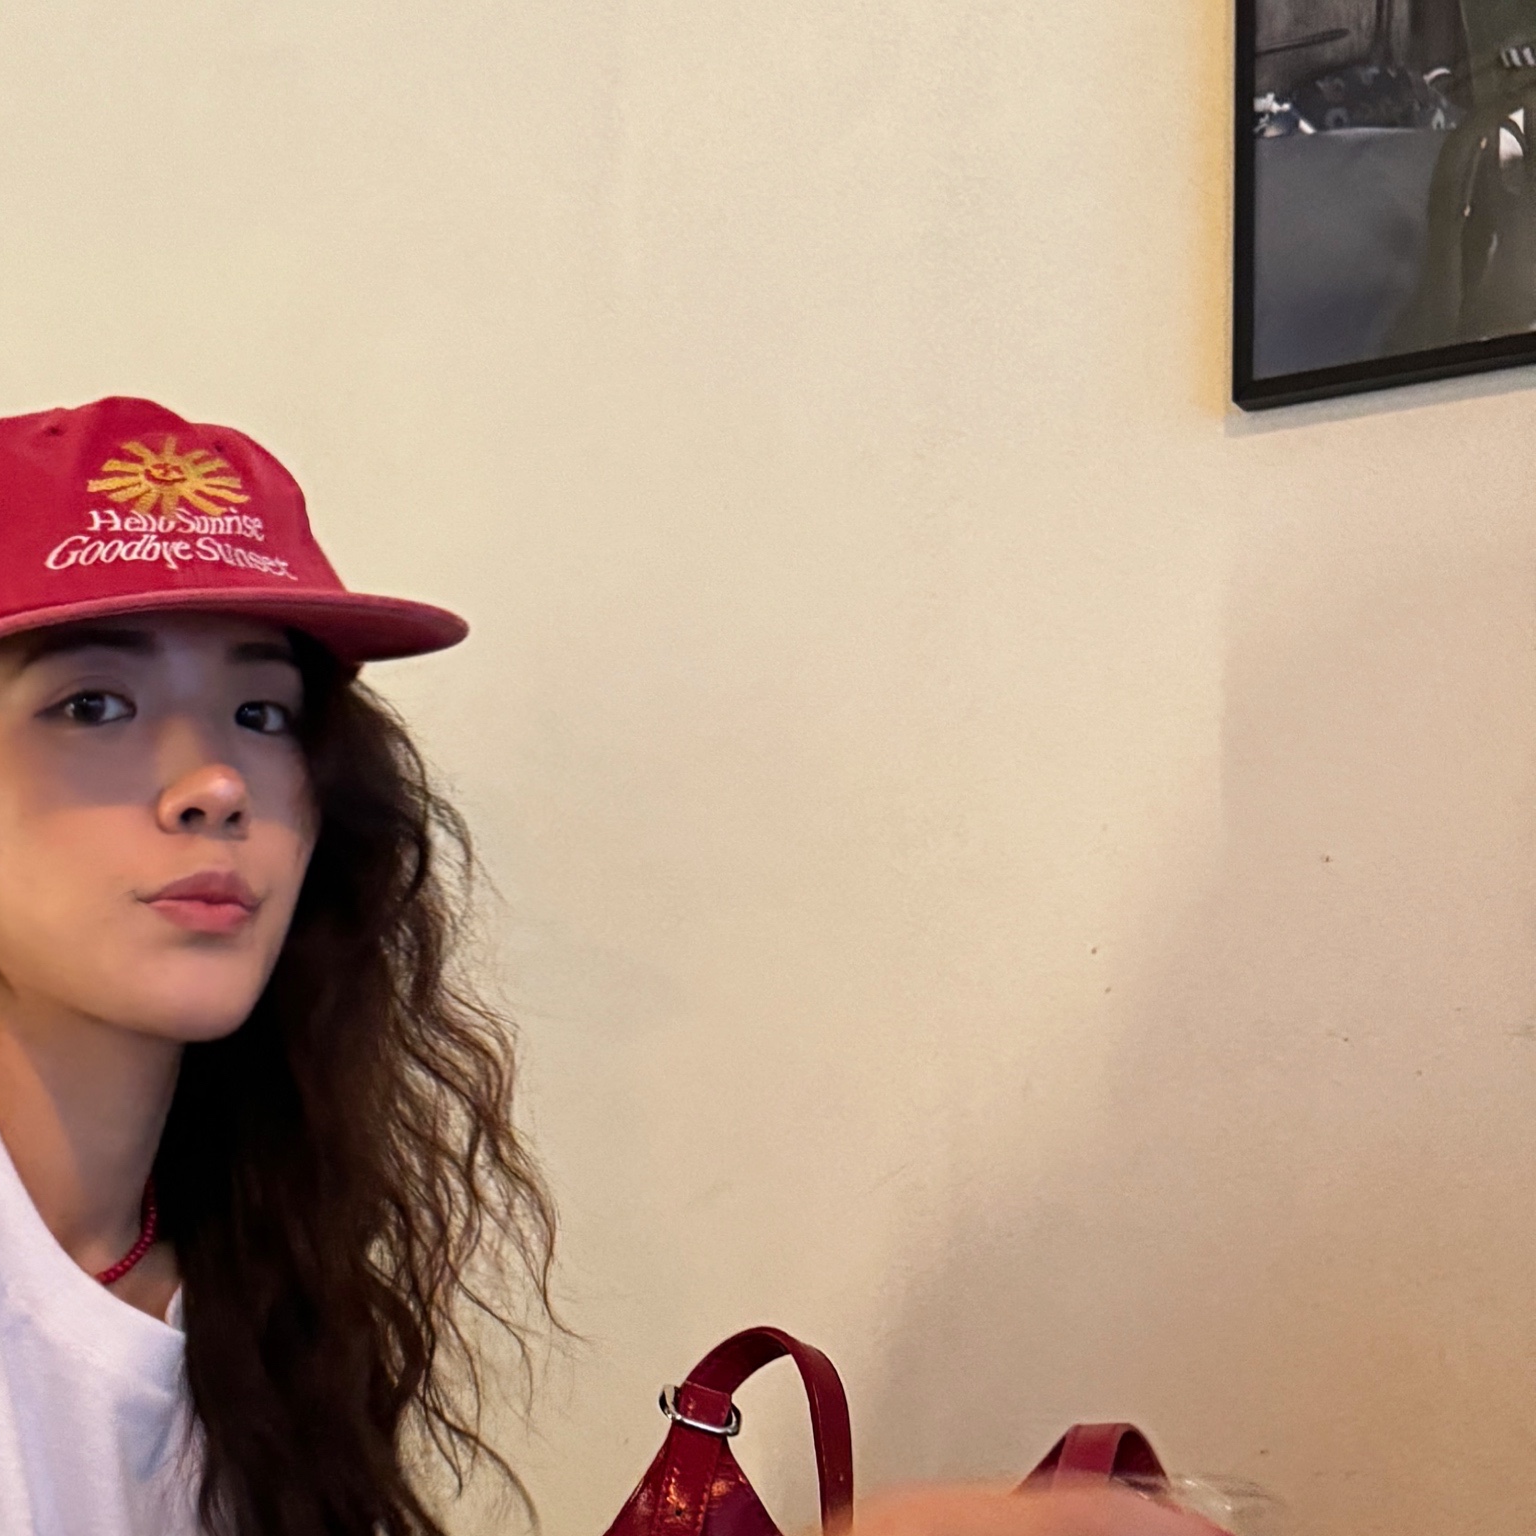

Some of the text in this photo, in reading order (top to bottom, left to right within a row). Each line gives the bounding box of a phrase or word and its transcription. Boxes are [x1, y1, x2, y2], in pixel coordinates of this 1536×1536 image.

[88, 508, 265, 541] Hello Sunrise
[44, 534, 298, 581] Goodbye Sunset
